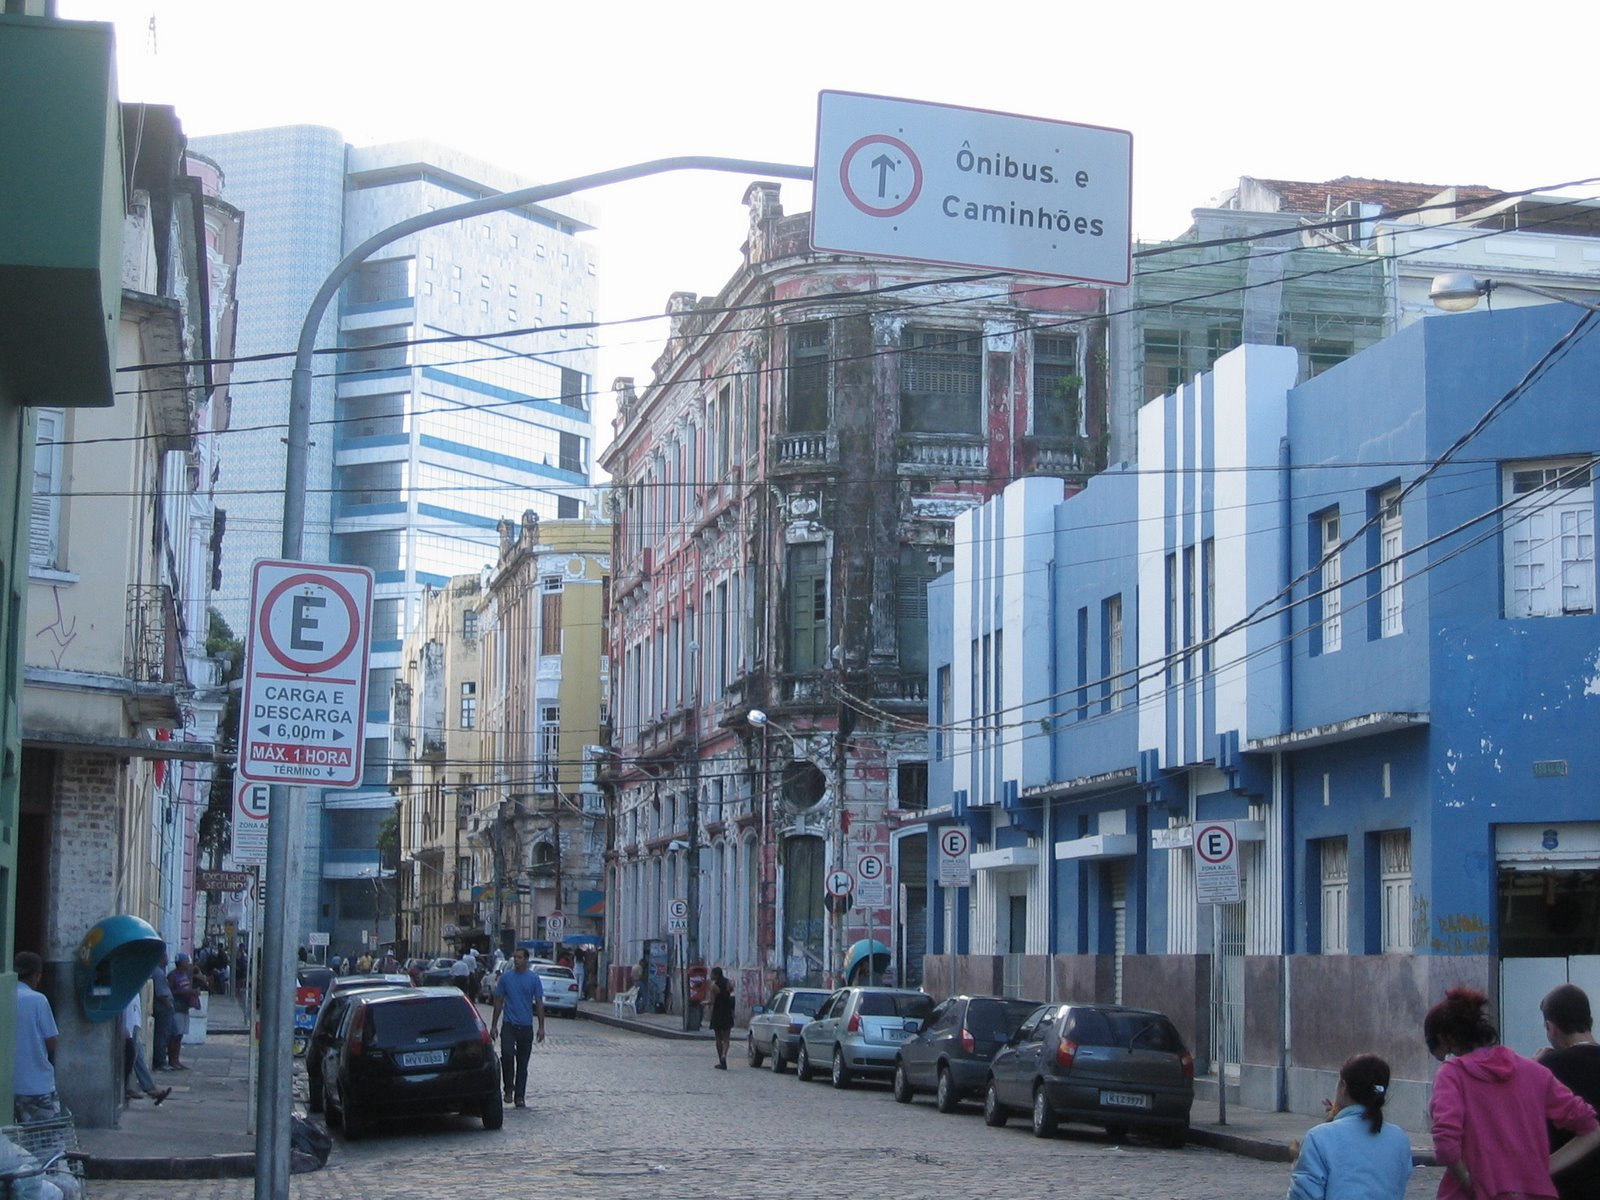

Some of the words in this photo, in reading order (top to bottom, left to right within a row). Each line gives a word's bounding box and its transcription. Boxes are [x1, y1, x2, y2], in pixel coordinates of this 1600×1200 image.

[955, 140, 1054, 184] Ônibus
[1075, 170, 1090, 188] e
[942, 195, 1104, 237] Caminhões
[290, 595, 326, 651] E
[265, 686, 328, 704] CARGA
[333, 691, 344, 705] E
[254, 704, 353, 724] DESCARGA
[277, 723, 326, 740] 6,00m
[252, 743, 289, 761] MÁX.
[293, 748, 300, 762] 1
[305, 749, 349, 765] HORA
[273, 764, 320, 777] TÉRMINO
[252, 786, 267, 810] E
[950, 836, 959, 851] E
[1208, 834, 1222, 855] E
[202, 872, 246, 880] EXCELSIO
[866, 860, 874, 874] E
[676, 903, 683, 914] E
[670, 920, 687, 929] TAX
